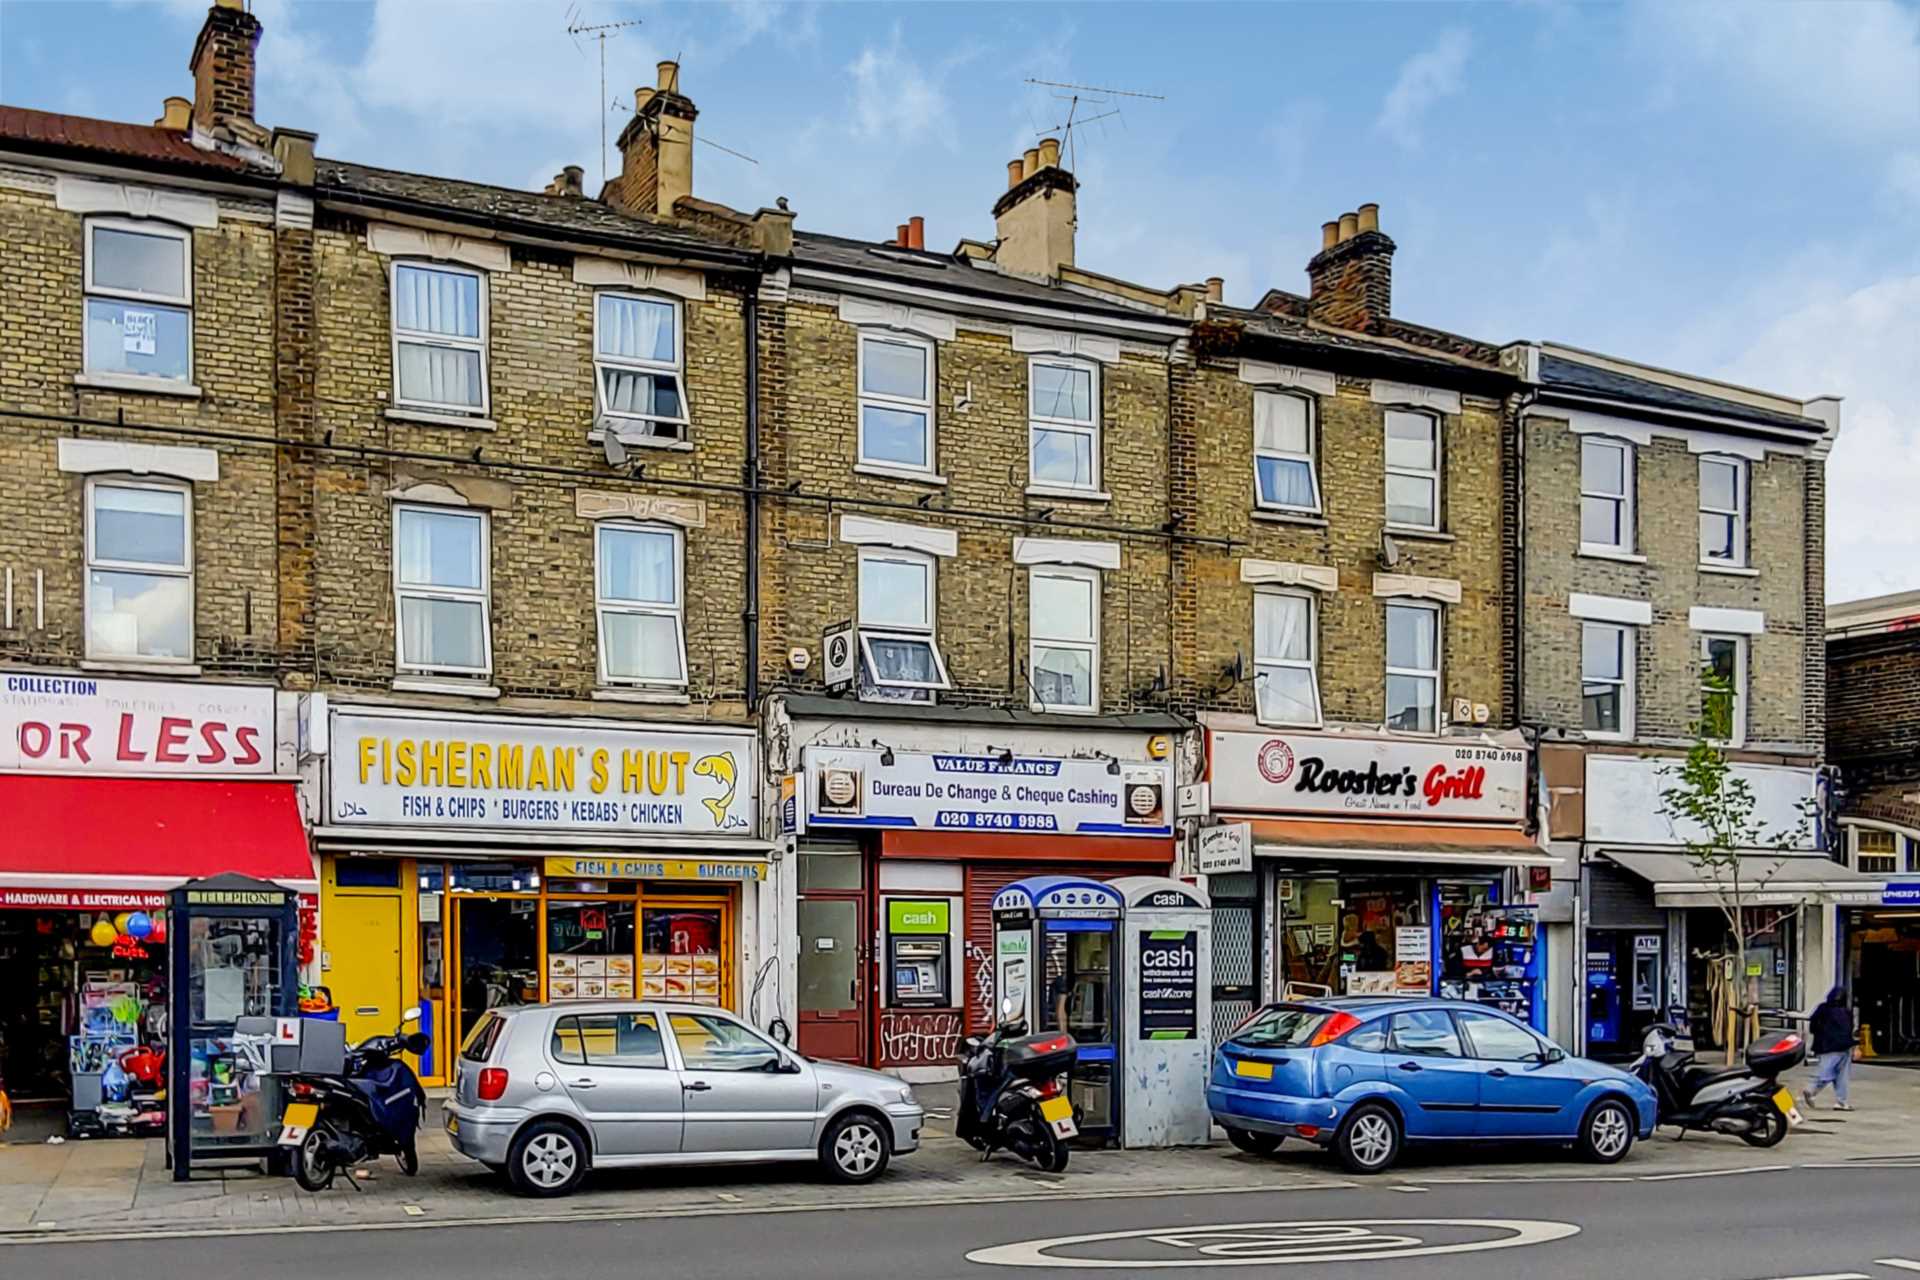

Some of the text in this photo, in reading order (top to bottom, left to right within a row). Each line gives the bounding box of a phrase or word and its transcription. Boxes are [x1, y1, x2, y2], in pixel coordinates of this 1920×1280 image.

[8, 677, 97, 696] COLLECTION
[20, 712, 262, 766] OR LESS
[1455, 749, 1522, 762] 020 8740 6968
[358, 735, 691, 796] FISHERMAN'S HUT
[936, 758, 1056, 775] VALUE FINANCE
[1295, 757, 1418, 796] Rooster's
[1423, 760, 1485, 807] Grill
[872, 780, 1118, 809] Bureau De Change & Cheque Cashing
[337, 801, 368, 819] حلال
[402, 795, 682, 825] FISH & CHIPS BURGERS KEBABS CHICKEN
[941, 813, 1055, 829] 020 8740 9988
[575, 861, 605, 875] FISH
[624, 863, 664, 877] CHIPS
[698, 864, 759, 879] BURGERS
[5, 893, 68, 905] HARDWARE
[71, 894, 80, 905] &
[84, 894, 142, 906] ELECTRICAL
[1153, 892, 1185, 906] cash
[903, 911, 937, 925] cash
[1637, 938, 1659, 948] ATM
[1142, 945, 1194, 967] cash
[282, 1023, 293, 1039] L
[287, 1126, 299, 1139] L
[1057, 1121, 1071, 1134] L
